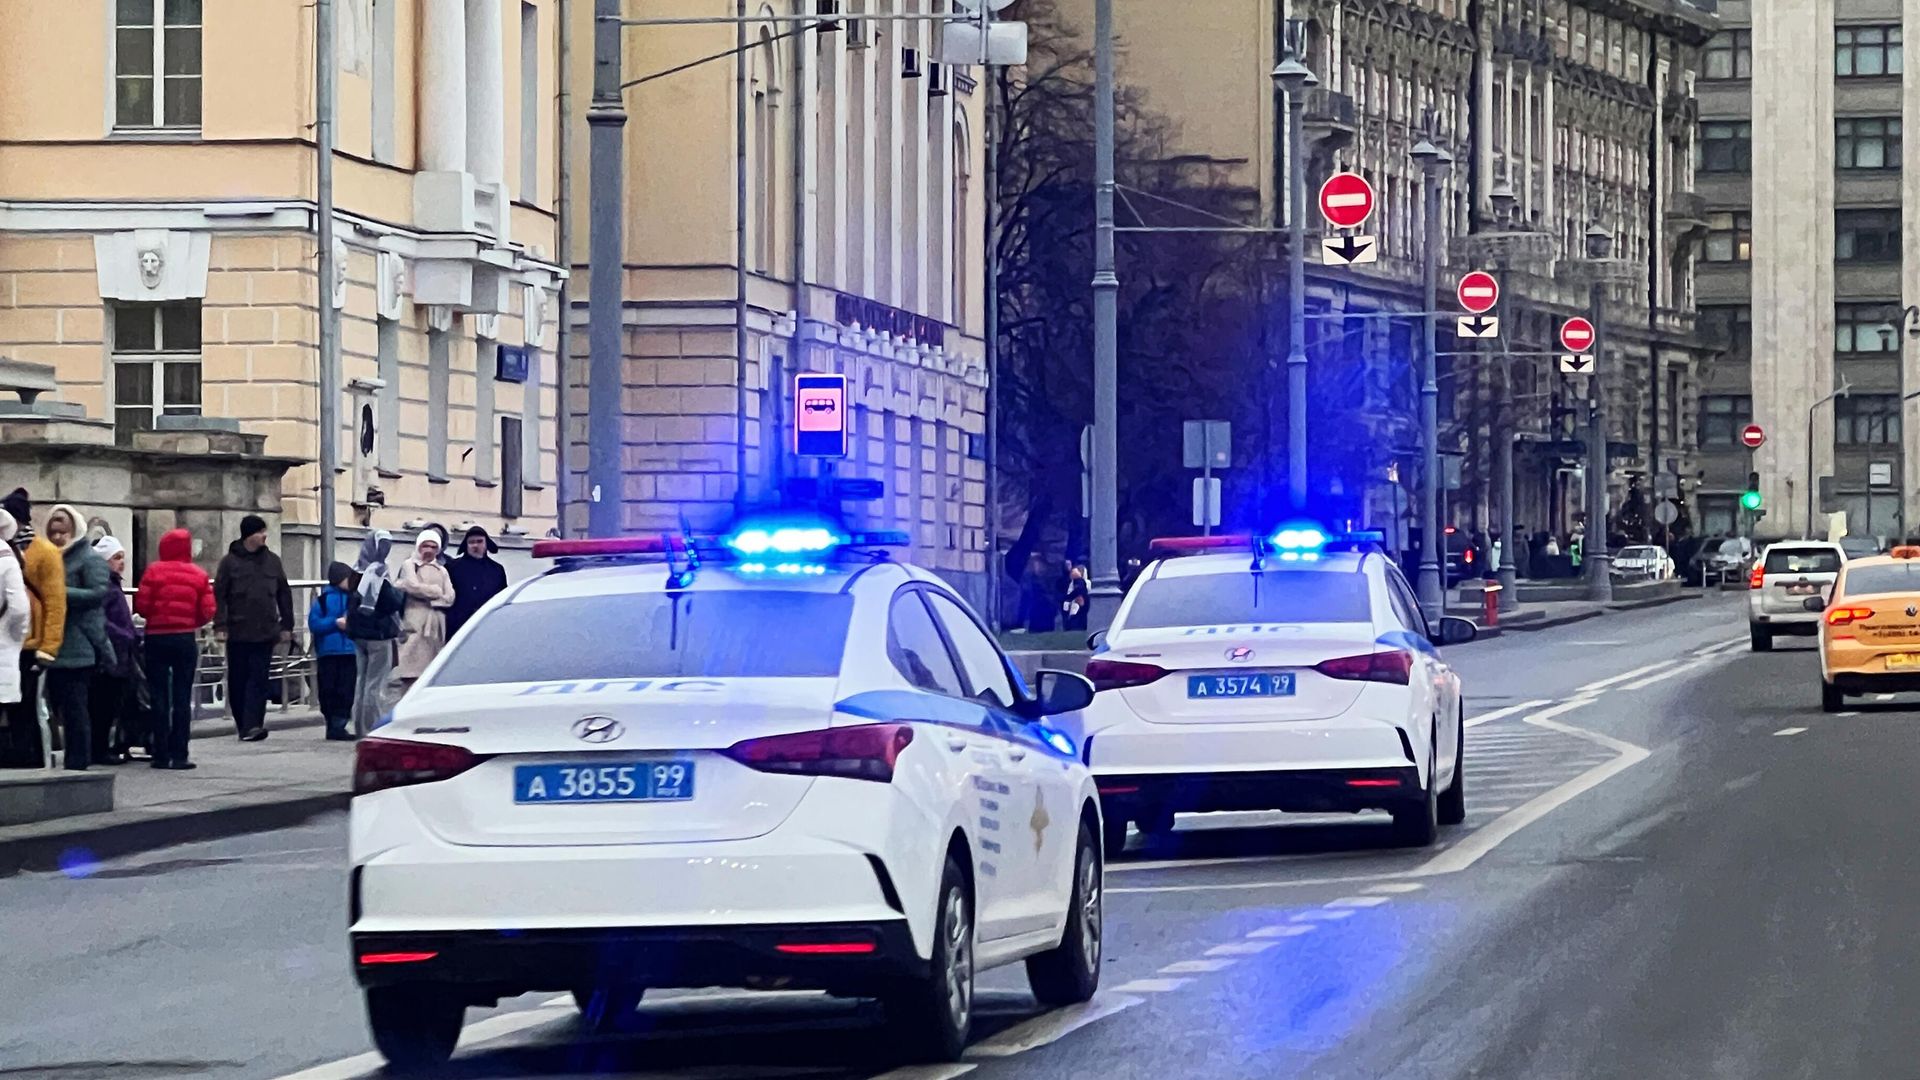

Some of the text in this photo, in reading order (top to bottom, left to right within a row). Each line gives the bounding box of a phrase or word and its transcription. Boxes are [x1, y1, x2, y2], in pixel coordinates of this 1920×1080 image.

[1197, 675, 1290, 696] А 3574 99
[528, 765, 685, 798] А 3855 99
